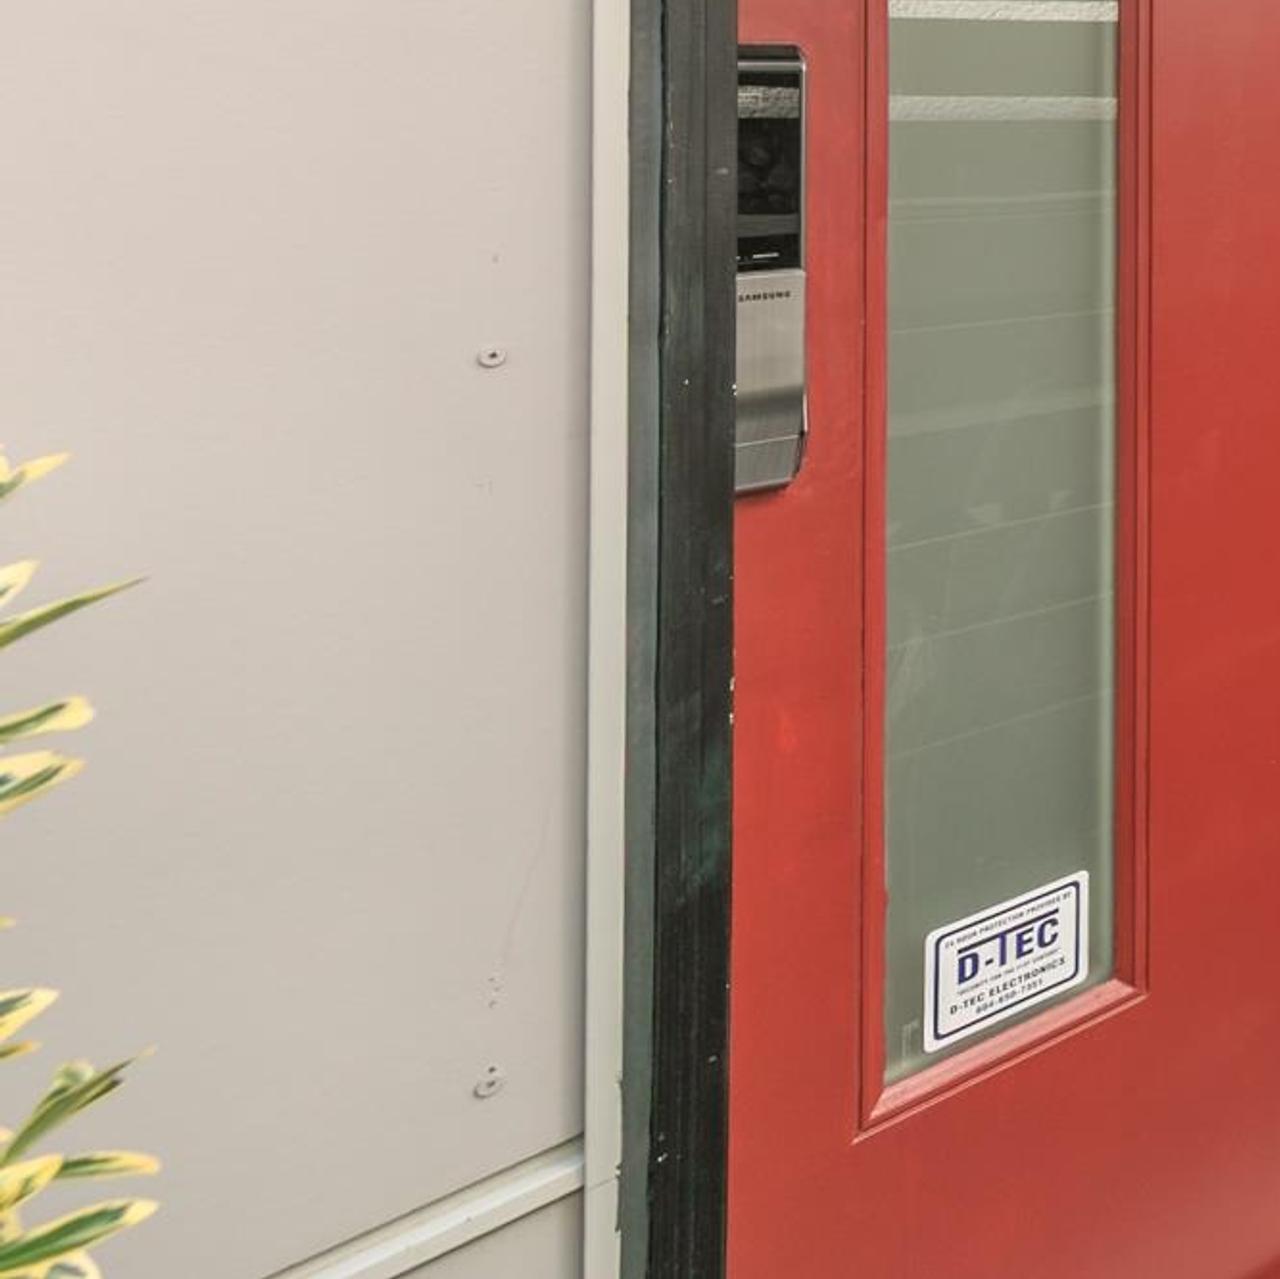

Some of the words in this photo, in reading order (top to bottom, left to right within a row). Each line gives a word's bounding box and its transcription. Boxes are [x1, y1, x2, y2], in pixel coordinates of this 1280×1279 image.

[739, 290, 791, 302] SAMSUNG
[957, 908, 1059, 985] D-TEC
[950, 992, 985, 1015] D-TEC
[989, 956, 1065, 997] ELECTRONICS
